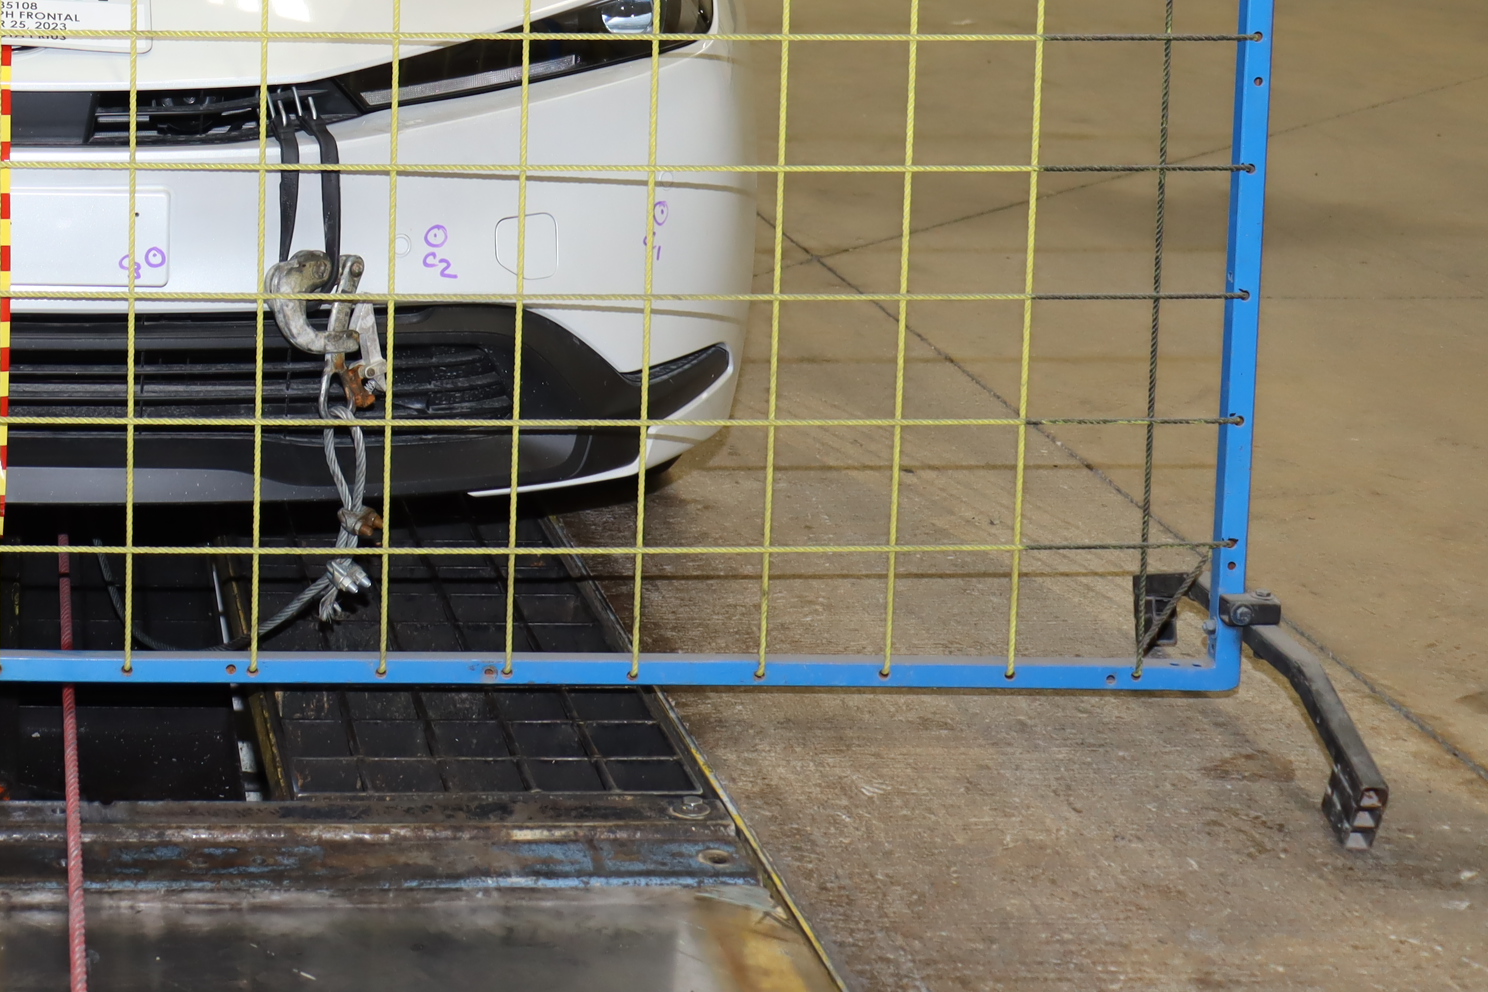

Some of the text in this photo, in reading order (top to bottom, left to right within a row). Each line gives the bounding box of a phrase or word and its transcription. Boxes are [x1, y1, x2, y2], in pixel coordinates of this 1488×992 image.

[19, 11, 80, 22] FRONTAL
[35, 21, 67, 31] 2023
[423, 251, 458, 279] C2
